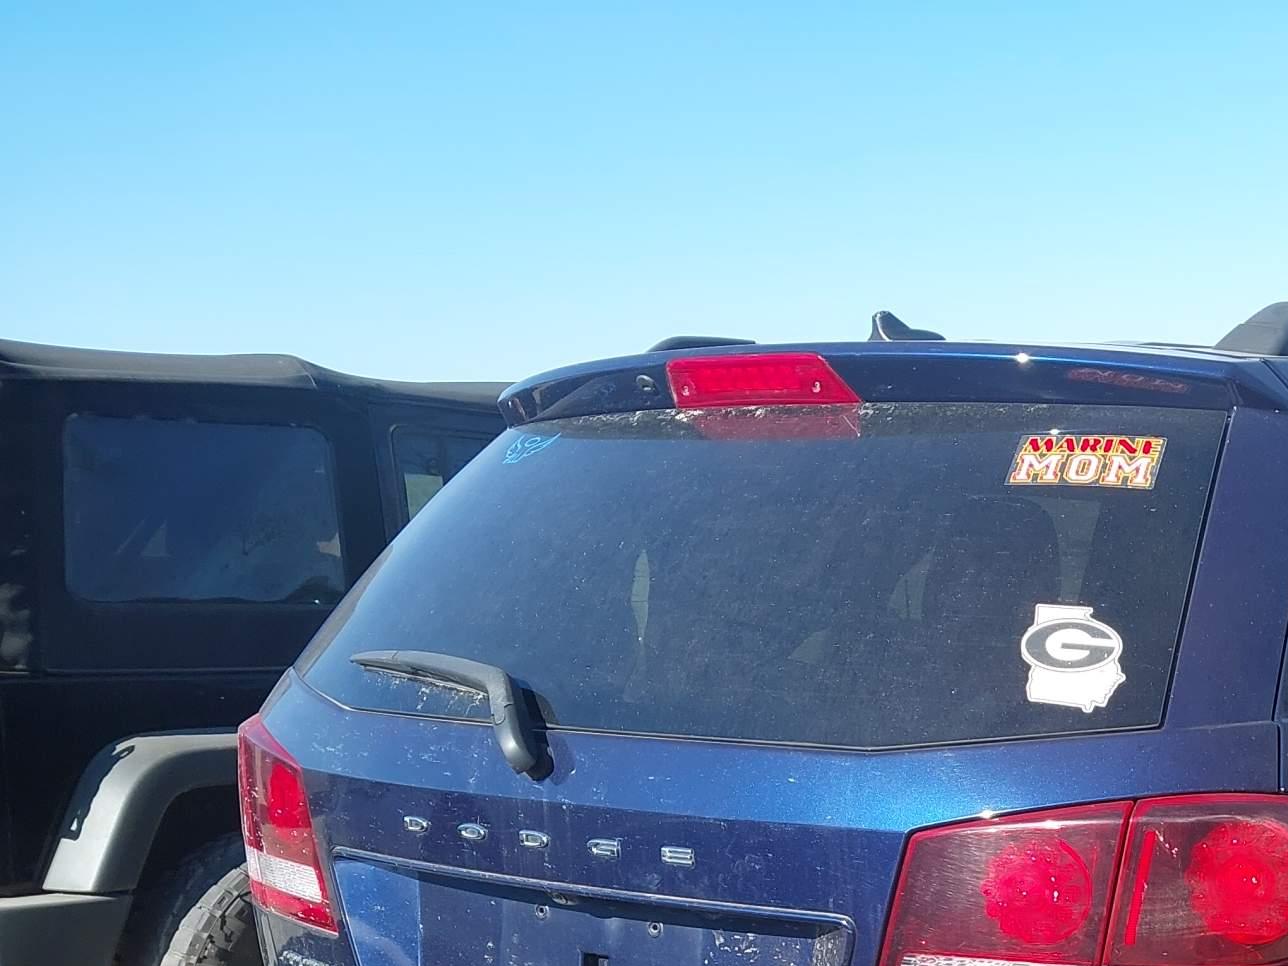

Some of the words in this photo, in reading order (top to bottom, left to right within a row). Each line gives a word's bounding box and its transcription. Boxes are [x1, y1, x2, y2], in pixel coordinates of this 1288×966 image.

[1023, 436, 1164, 456] MARINE
[1010, 453, 1160, 487] MOM
[1045, 628, 1114, 661] G
[403, 815, 696, 868] DODGE
